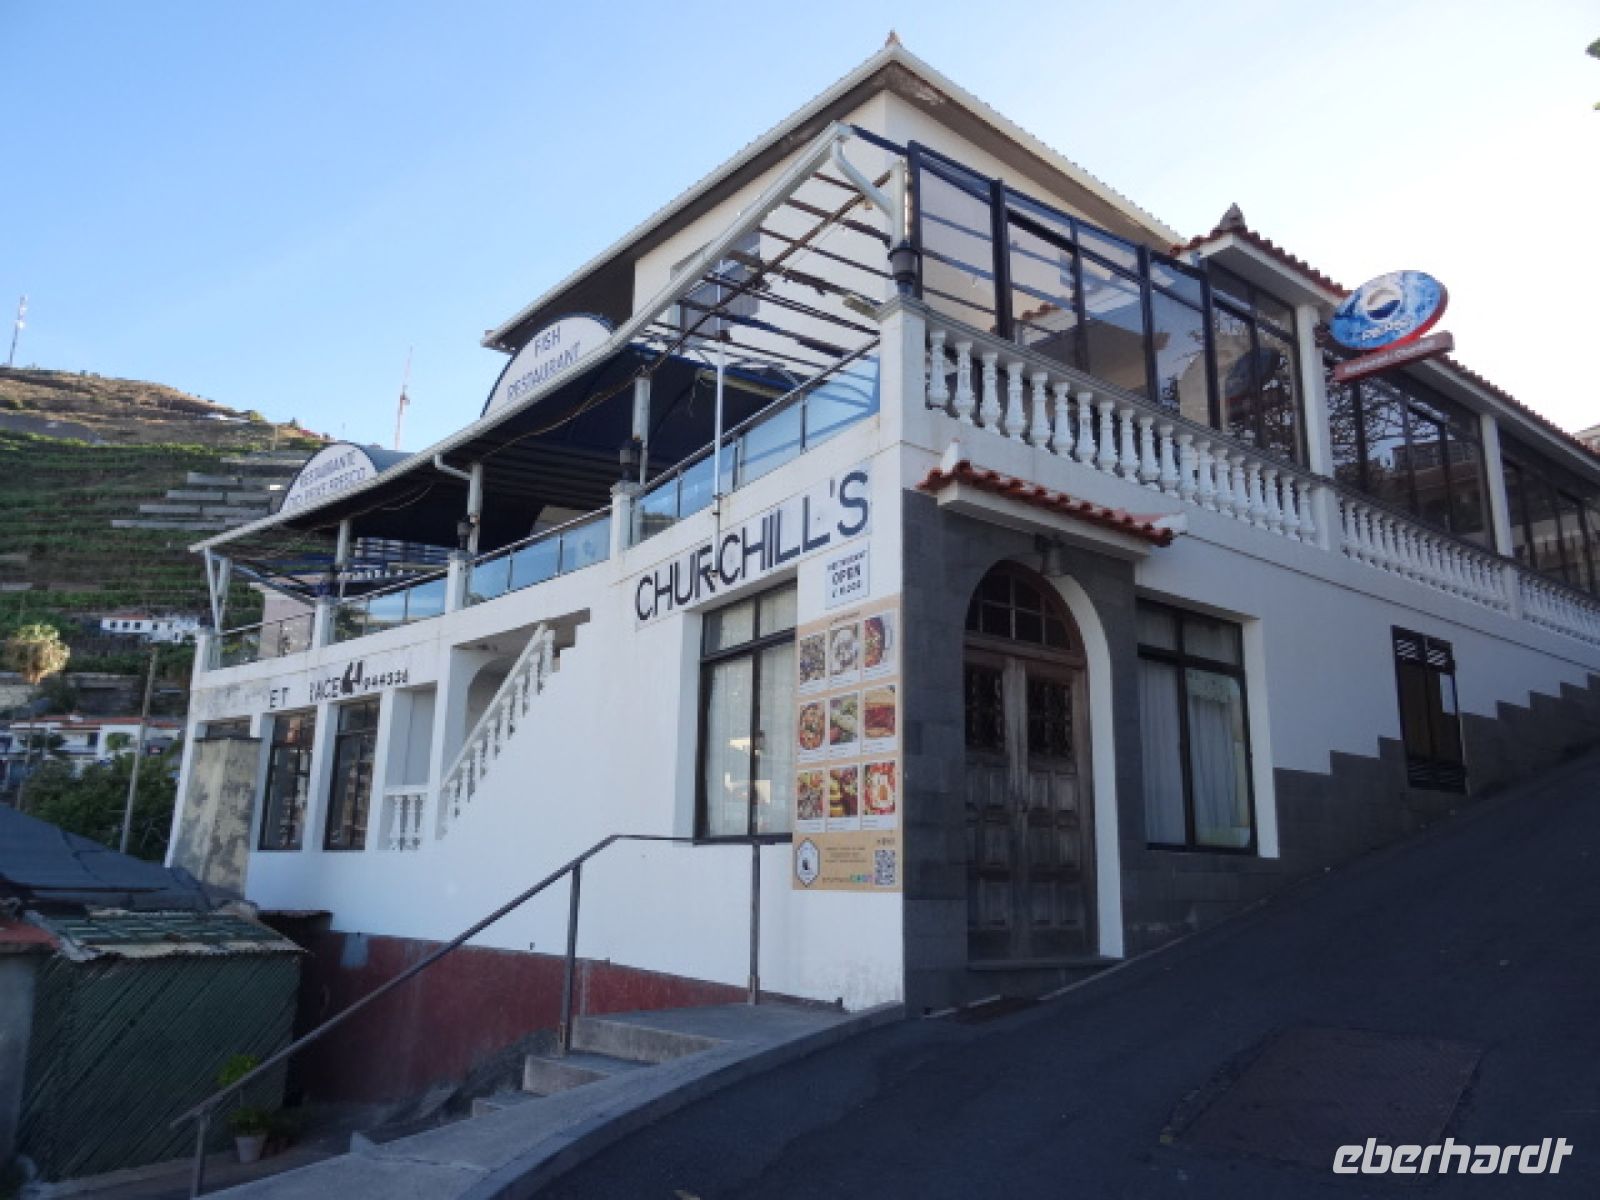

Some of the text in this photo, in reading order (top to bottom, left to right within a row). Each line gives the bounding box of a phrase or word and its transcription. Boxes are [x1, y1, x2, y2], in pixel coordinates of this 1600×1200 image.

[534, 324, 561, 358] FISH
[507, 339, 580, 401] RESTAURANT
[300, 448, 356, 489] RESTAURANTE
[635, 470, 869, 621] CHURCHILL'S
[832, 563, 861, 586] OPEN
